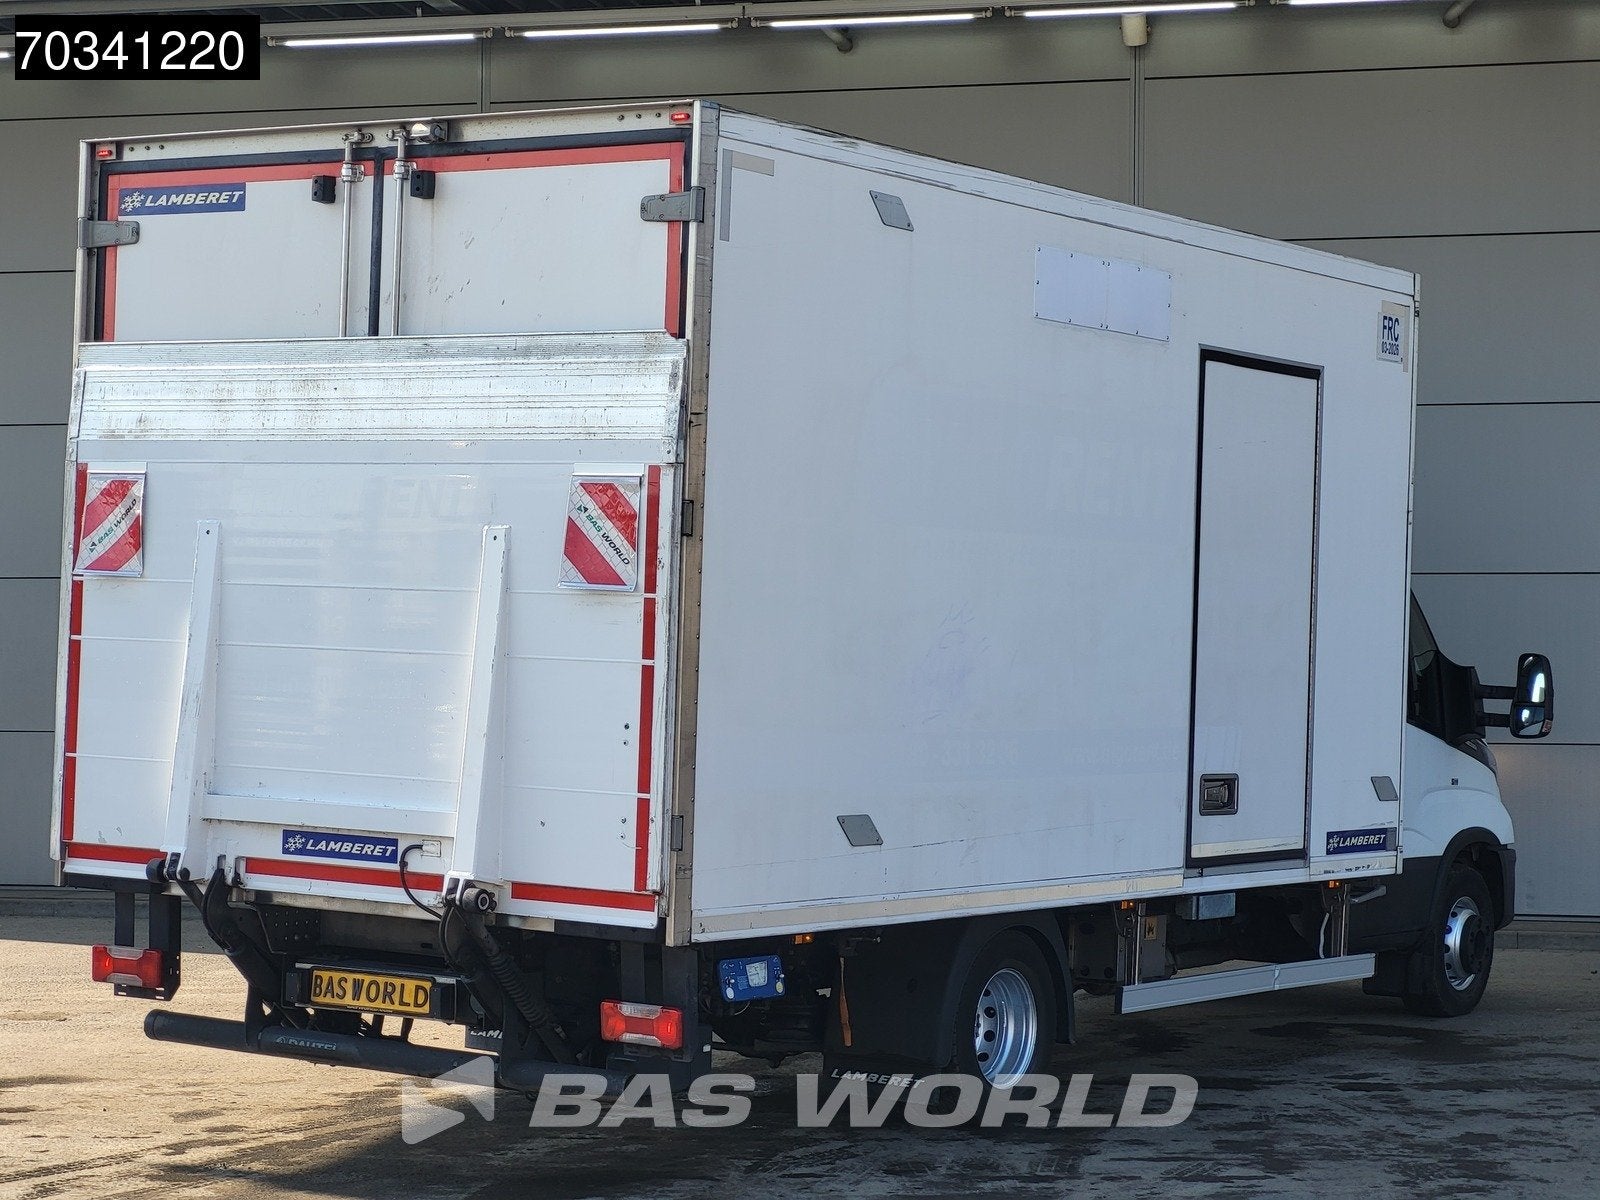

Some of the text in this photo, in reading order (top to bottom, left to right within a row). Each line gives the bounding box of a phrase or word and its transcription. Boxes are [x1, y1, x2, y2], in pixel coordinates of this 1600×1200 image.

[145, 190, 244, 207] LAMBERET
[1382, 316, 1399, 342] FRC
[98, 498, 137, 543] BAS WORLD
[585, 514, 630, 565] BAS WORLD
[305, 838, 396, 857] LAMBERET
[1339, 834, 1386, 847] LAMBERET
[312, 974, 429, 1008] BAS WORLD
[830, 1068, 926, 1089] LAMBERET
